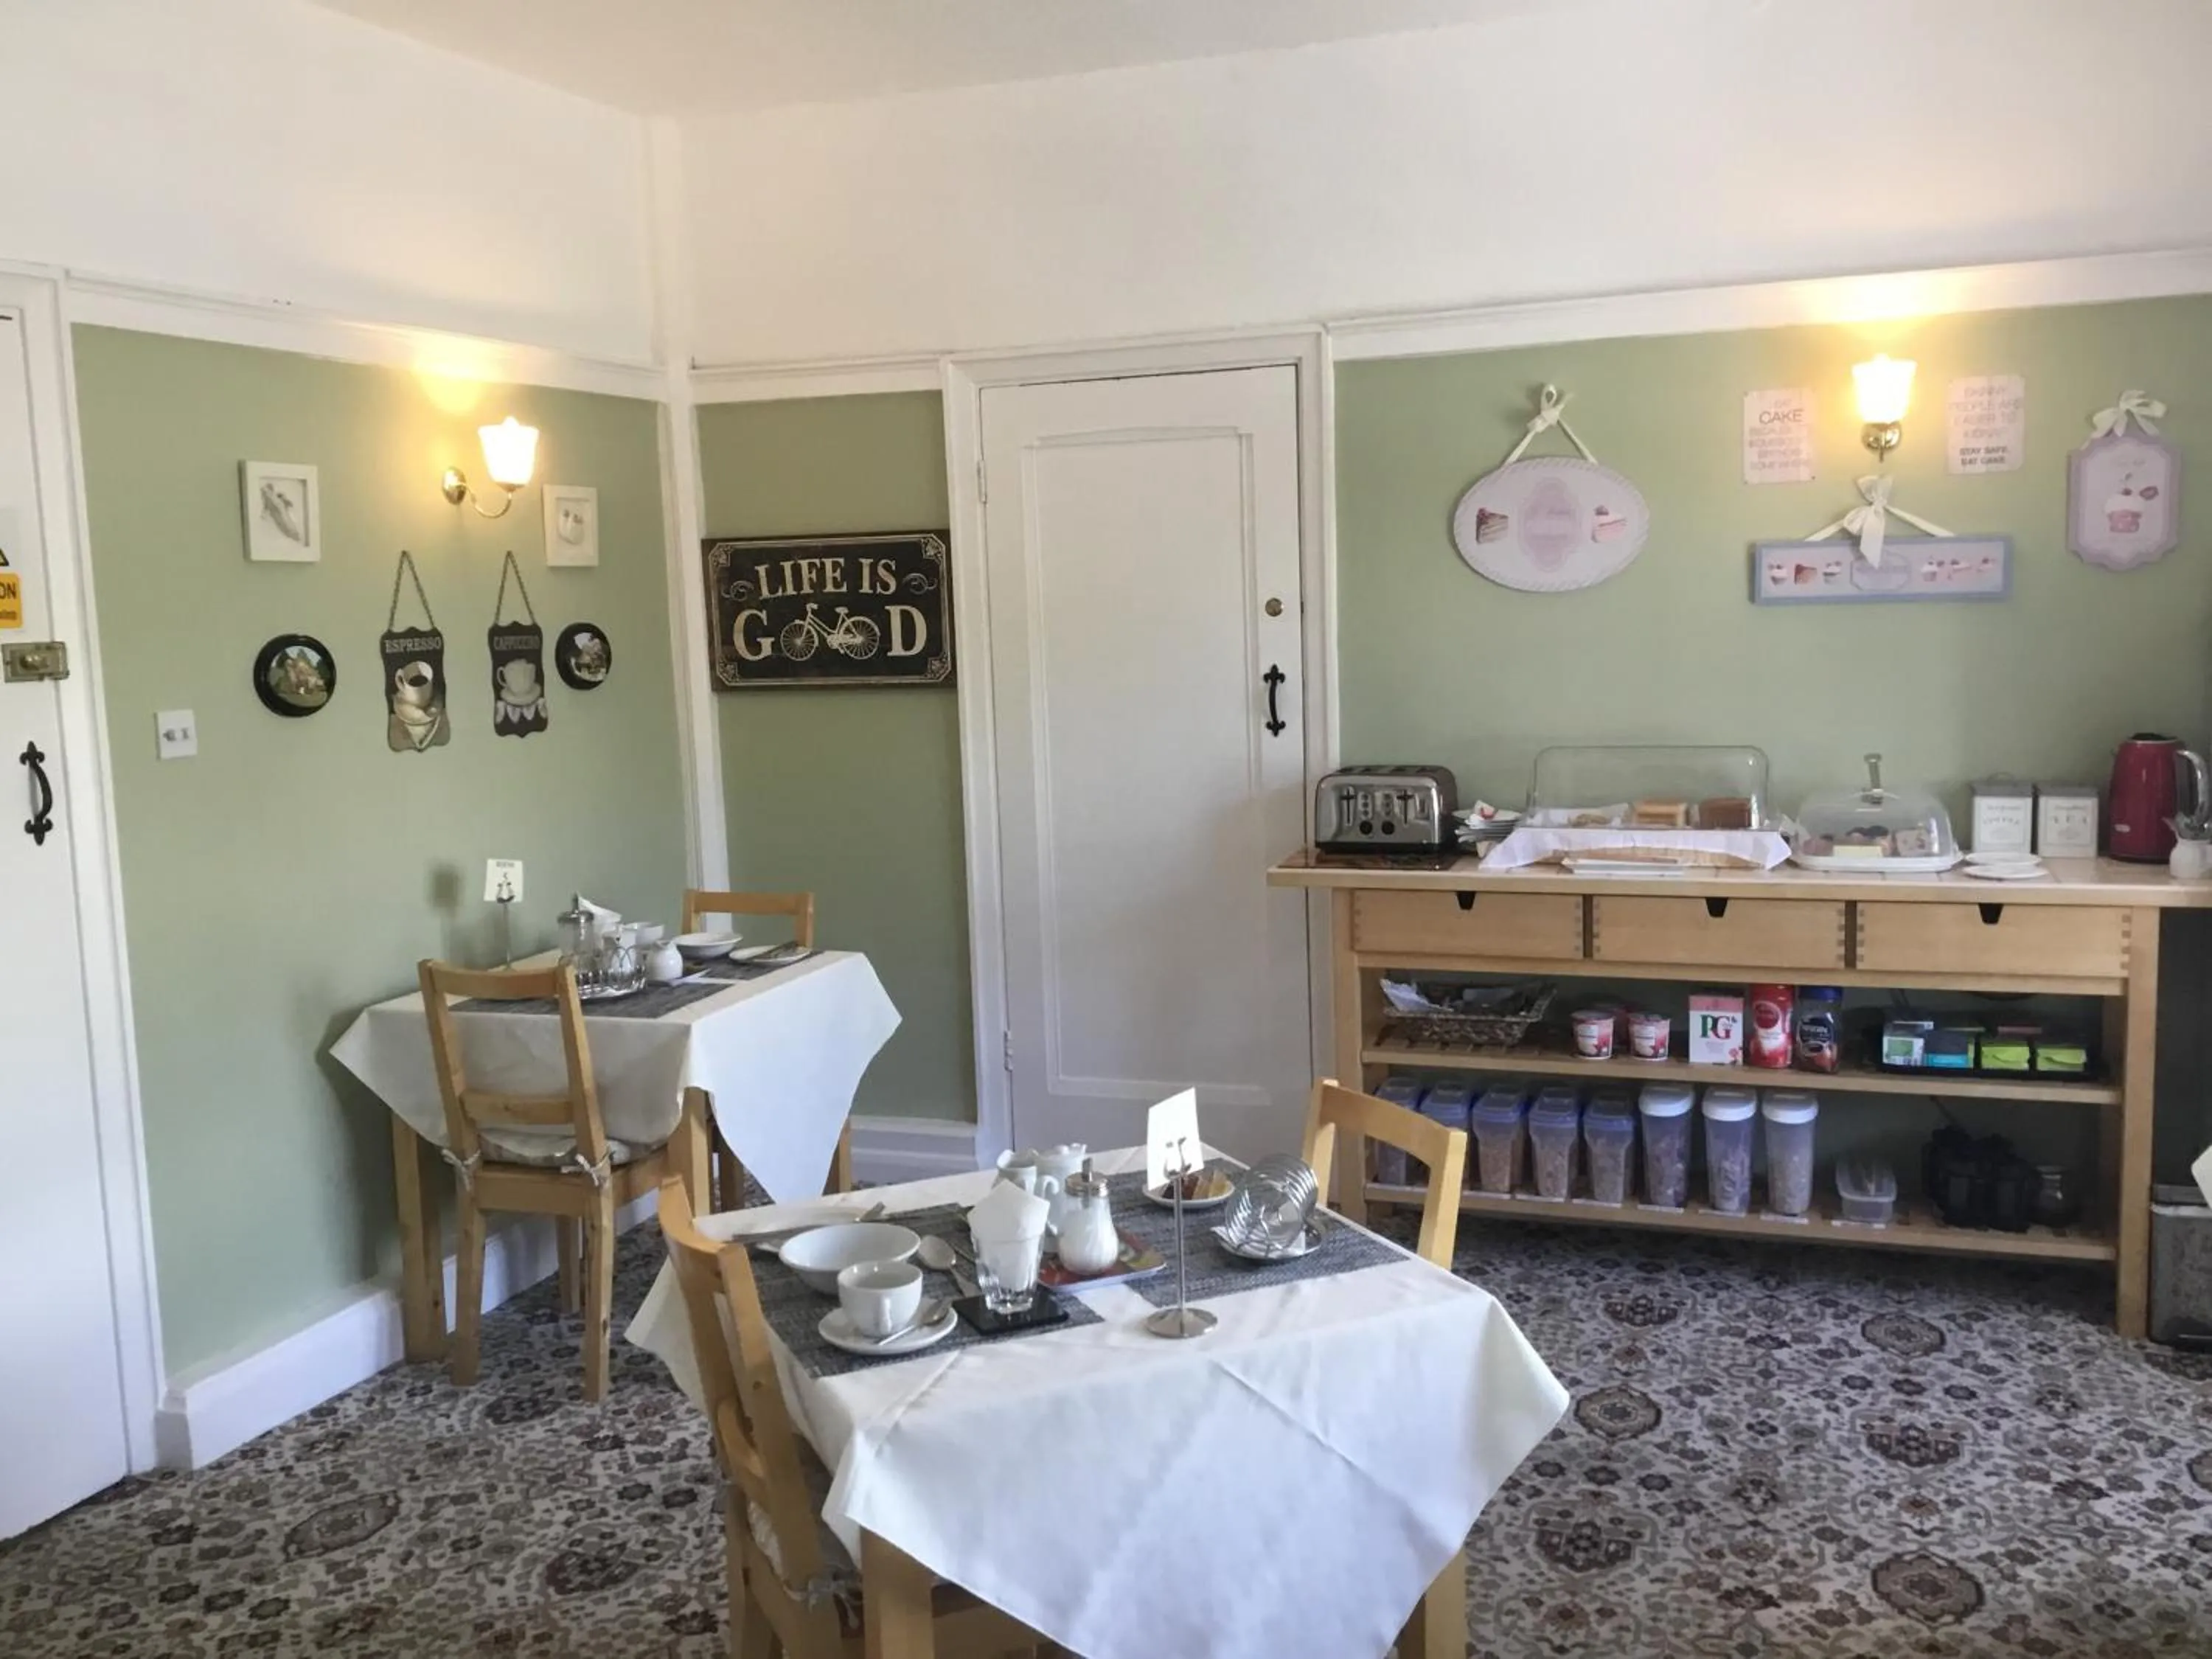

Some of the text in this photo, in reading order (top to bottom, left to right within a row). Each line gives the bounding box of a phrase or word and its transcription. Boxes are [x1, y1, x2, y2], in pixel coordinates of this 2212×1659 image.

[1759, 408, 1805, 425] CAKE
[754, 557, 898, 600] LIFE IS
[383, 636, 442, 654] ESPRESSO
[1699, 1014, 1733, 1040] PG
